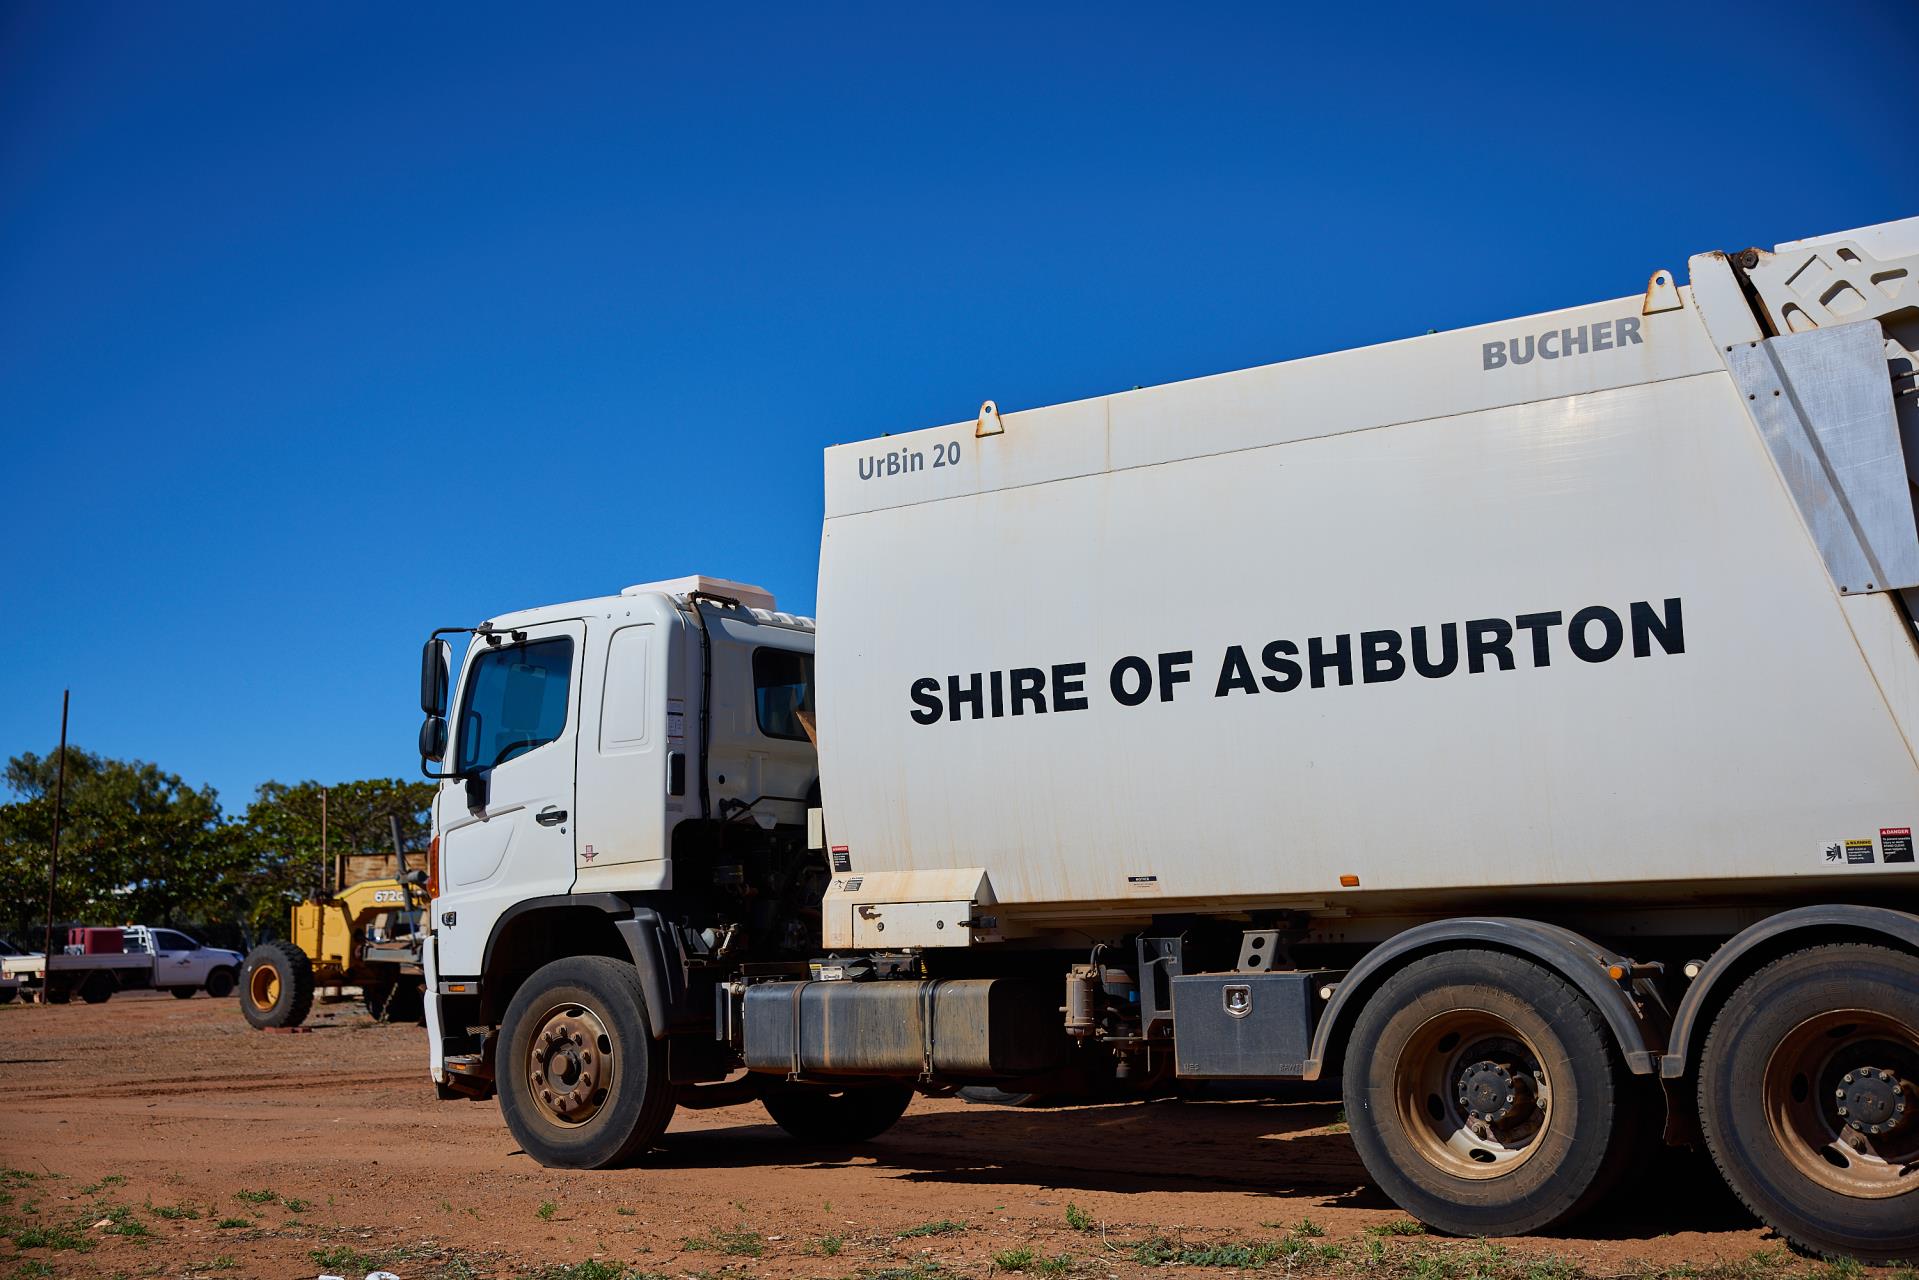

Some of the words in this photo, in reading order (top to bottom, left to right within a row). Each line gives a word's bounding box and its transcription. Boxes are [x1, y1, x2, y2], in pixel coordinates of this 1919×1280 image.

[1482, 316, 1643, 371] BUCHER
[858, 447, 924, 480] UrBin
[933, 441, 961, 468] 20
[909, 662, 1089, 725] SHIRE
[1109, 650, 1193, 706] OF
[1214, 597, 1686, 698] ASHBURTON
